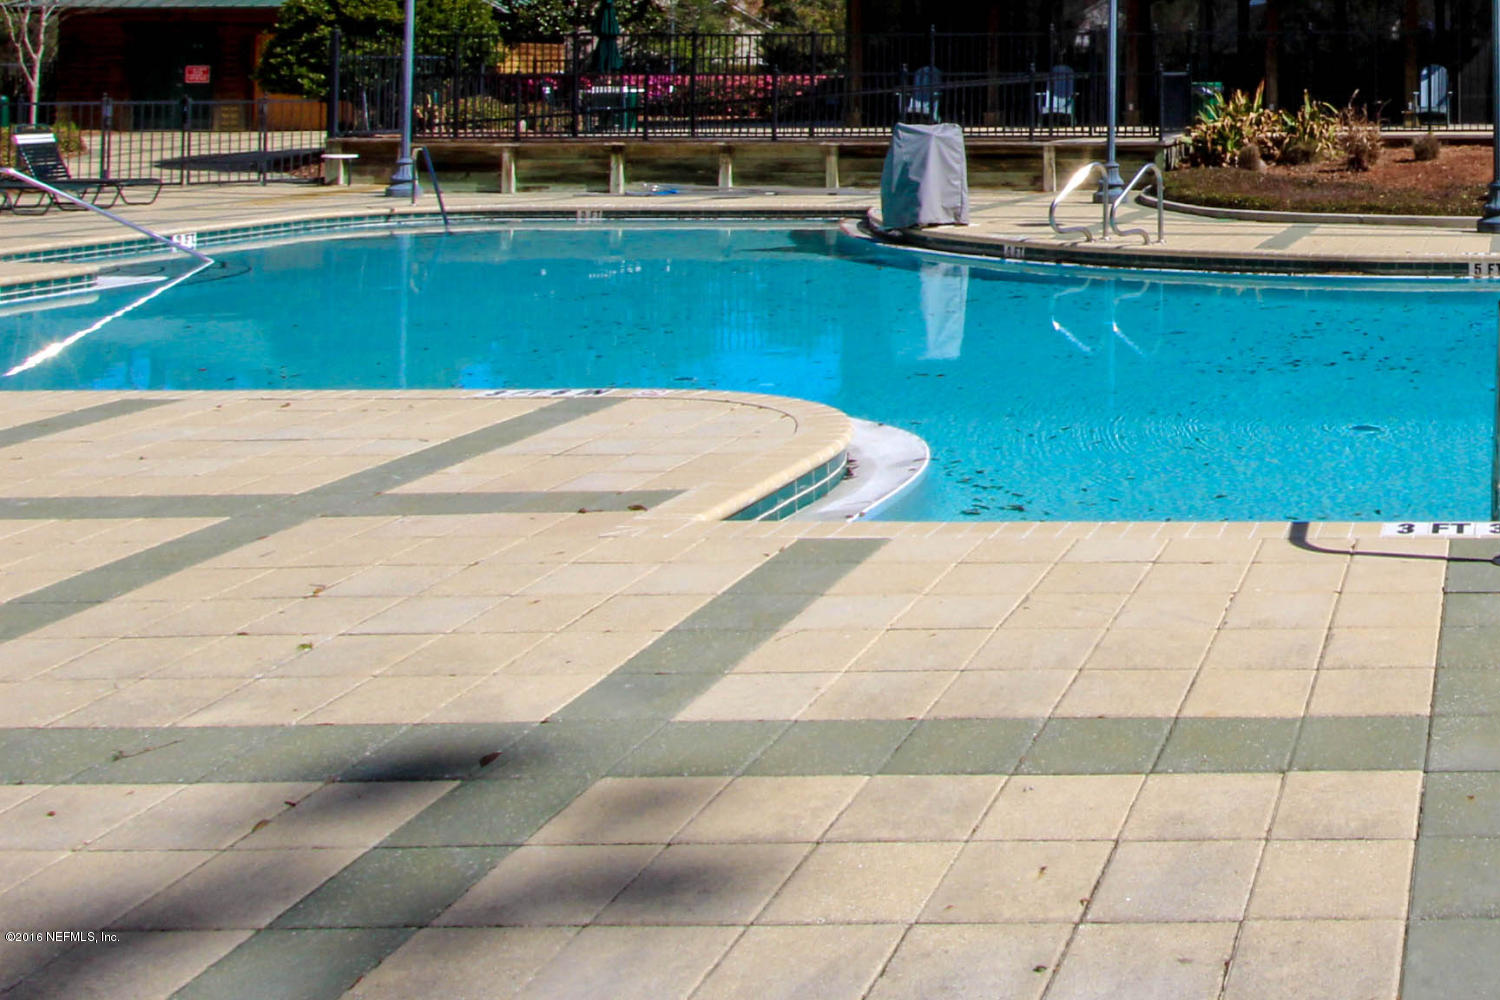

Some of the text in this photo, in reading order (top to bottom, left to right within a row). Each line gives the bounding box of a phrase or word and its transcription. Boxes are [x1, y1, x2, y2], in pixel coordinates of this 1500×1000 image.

[1474, 263, 1482, 275] 5
[1396, 523, 1415, 534] 3
[1431, 523, 1471, 534] FT
